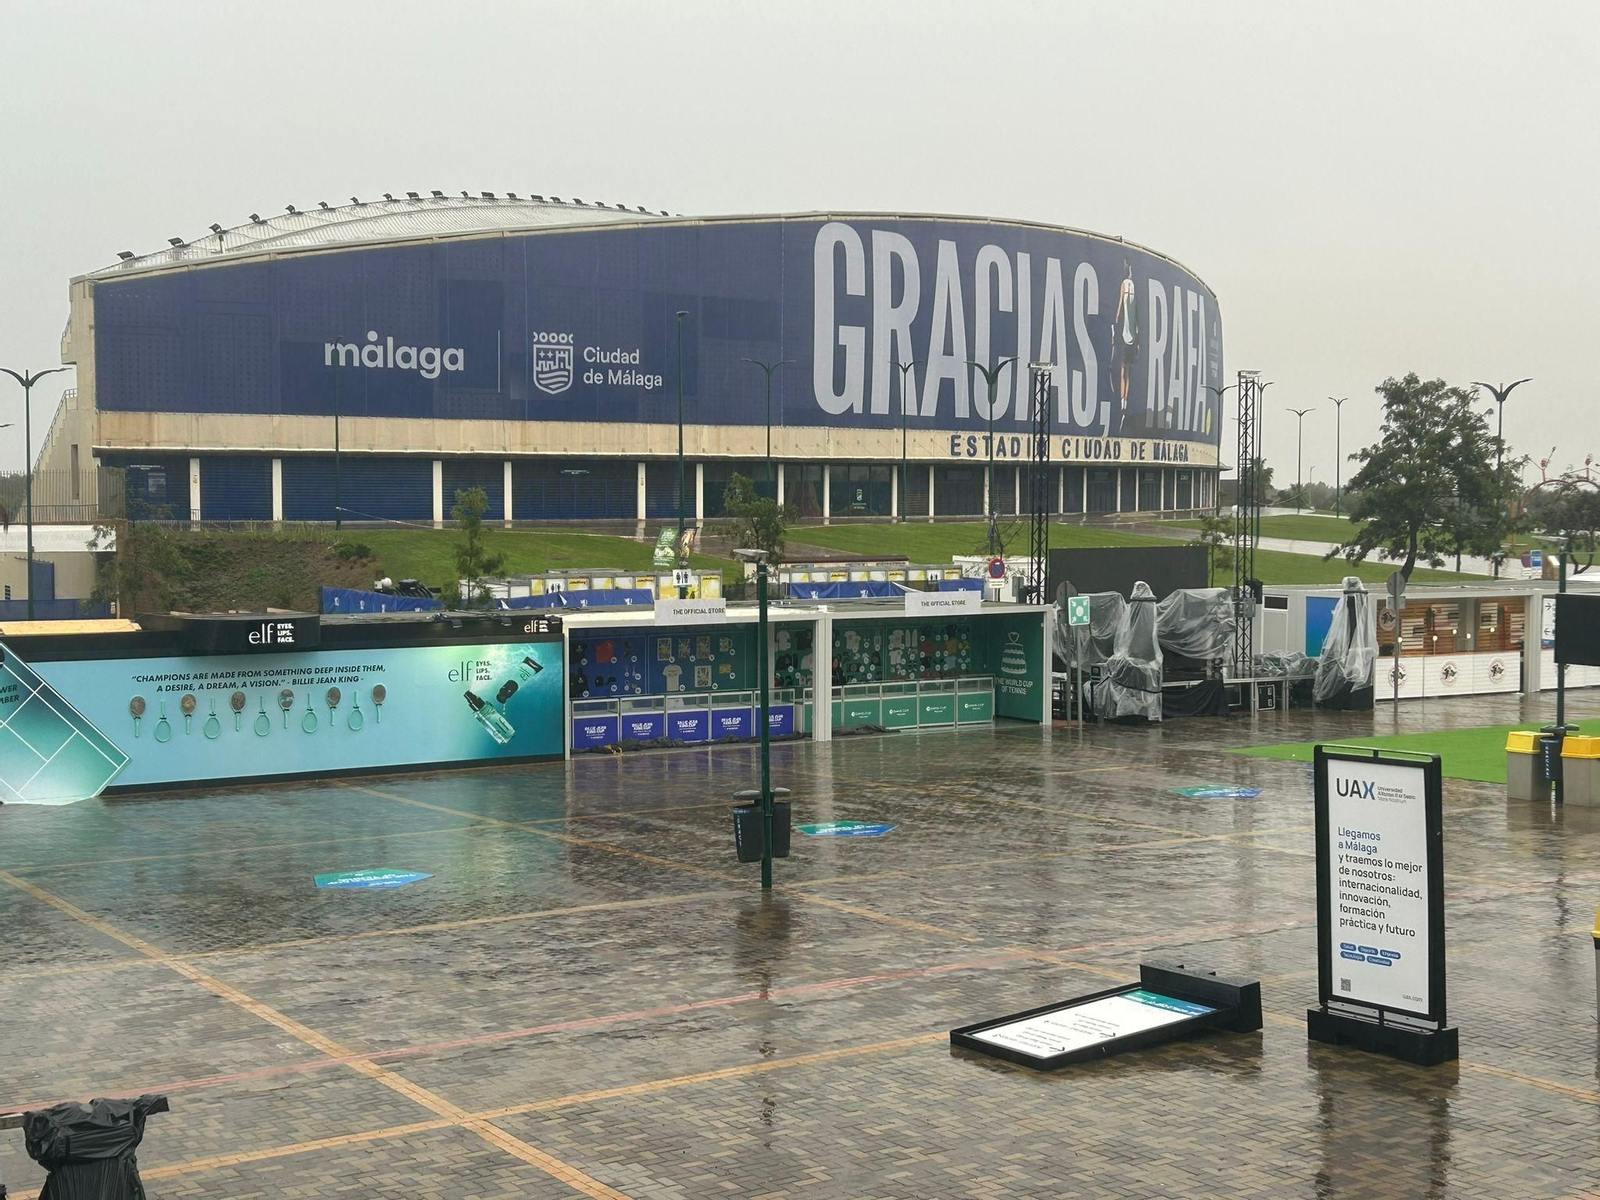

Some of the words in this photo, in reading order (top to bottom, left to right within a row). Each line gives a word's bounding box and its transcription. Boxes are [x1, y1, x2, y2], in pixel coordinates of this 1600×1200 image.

[813, 222, 1111, 438] GRACIAS,
[583, 346, 639, 365] Ciudad
[583, 368, 603, 385] de
[608, 368, 663, 388] Málaga
[1062, 437, 1121, 460] CIUDAD
[1131, 441, 1146, 460] DE
[192, 672, 209, 680] ARE
[210, 670, 236, 679] MADE
[237, 669, 261, 678] FROM
[263, 667, 313, 677] SOMETHING
[314, 666, 334, 675] DEEP
[335, 665, 361, 674] INSIDE
[362, 664, 386, 673] THEM,
[165, 683, 195, 692] DESIRE,
[206, 681, 240, 690] DREAM,
[292, 677, 315, 686] BILLIE
[316, 676, 337, 685] JEAN
[338, 675, 360, 684] KING
[1336, 777, 1375, 800] UAX
[1337, 826, 1381, 840] Llegamos
[1338, 841, 1343, 849] a
[1345, 840, 1378, 855] Málaga
[1338, 853, 1344, 863] y
[1345, 853, 1382, 867] traemos
[1384, 858, 1393, 868] lo
[1395, 861, 1422, 874] mejor
[1338, 865, 1350, 875] de
[1351, 868, 1396, 881] nosotros:
[1339, 877, 1422, 900] internacionalidad,
[1339, 890, 1391, 908] innovación,
[1339, 903, 1385, 919] formación
[1339, 917, 1377, 931] práctica
[1378, 924, 1384, 934] y
[1385, 923, 1416, 937] futuro
